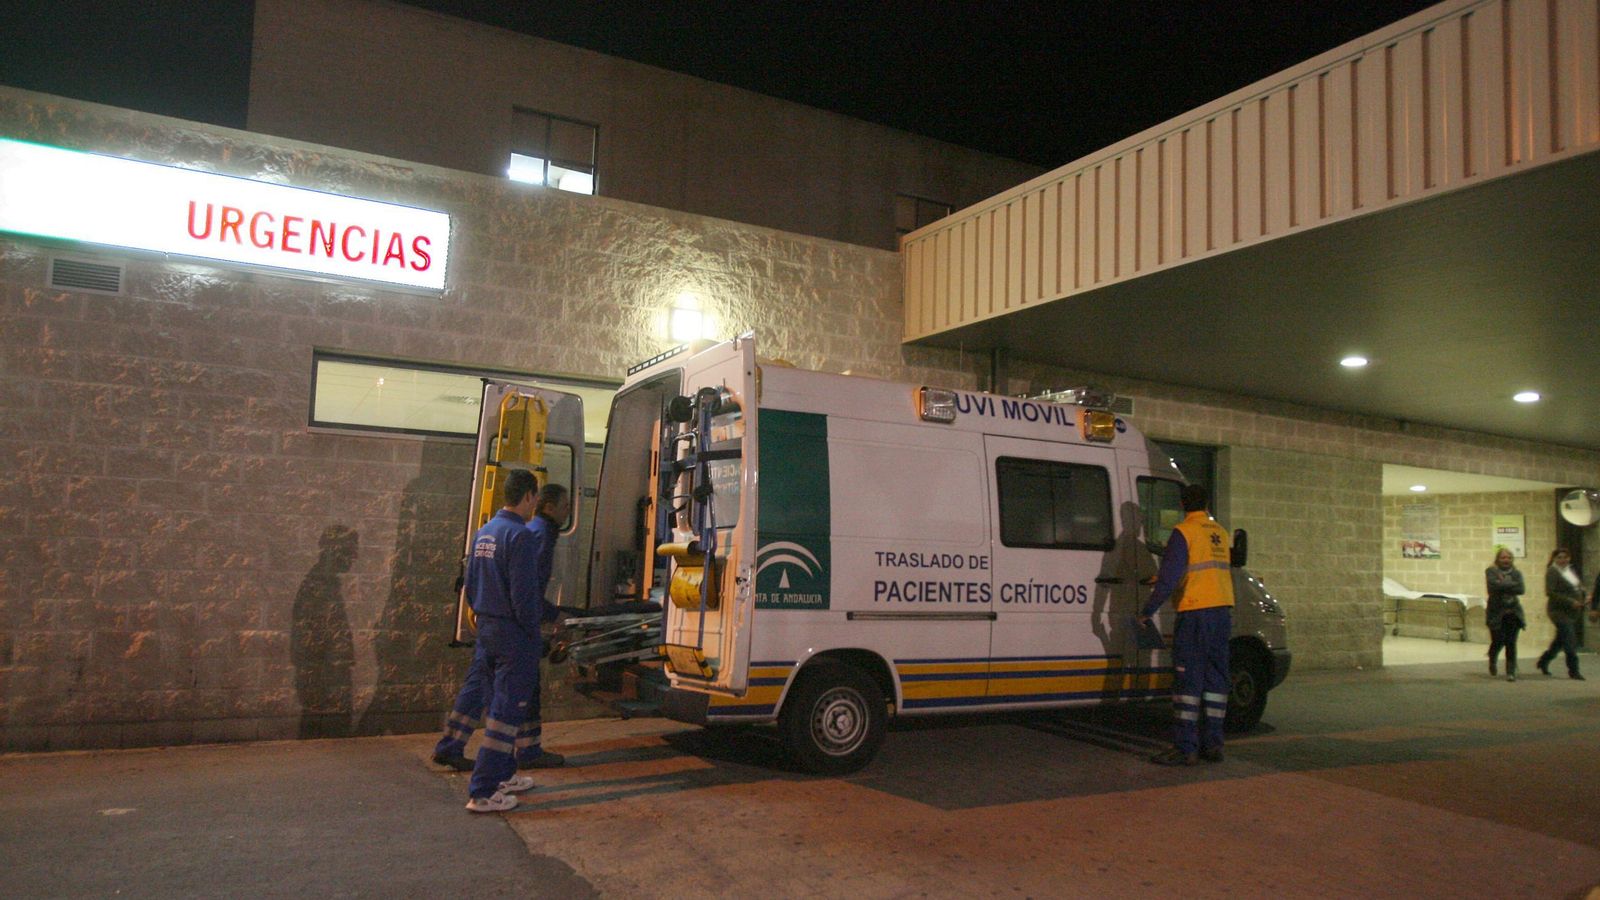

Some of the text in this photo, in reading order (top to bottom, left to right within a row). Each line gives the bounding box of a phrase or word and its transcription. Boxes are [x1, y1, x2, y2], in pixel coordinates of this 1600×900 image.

[187, 200, 432, 272] URGENCIAS
[954, 392, 1075, 427] UVI MOVIL
[874, 551, 989, 570] TRASLADO DE
[755, 592, 823, 605] NTA DE ANDALUCIA
[874, 578, 1088, 605] PACIENTES CRÍTICOS
